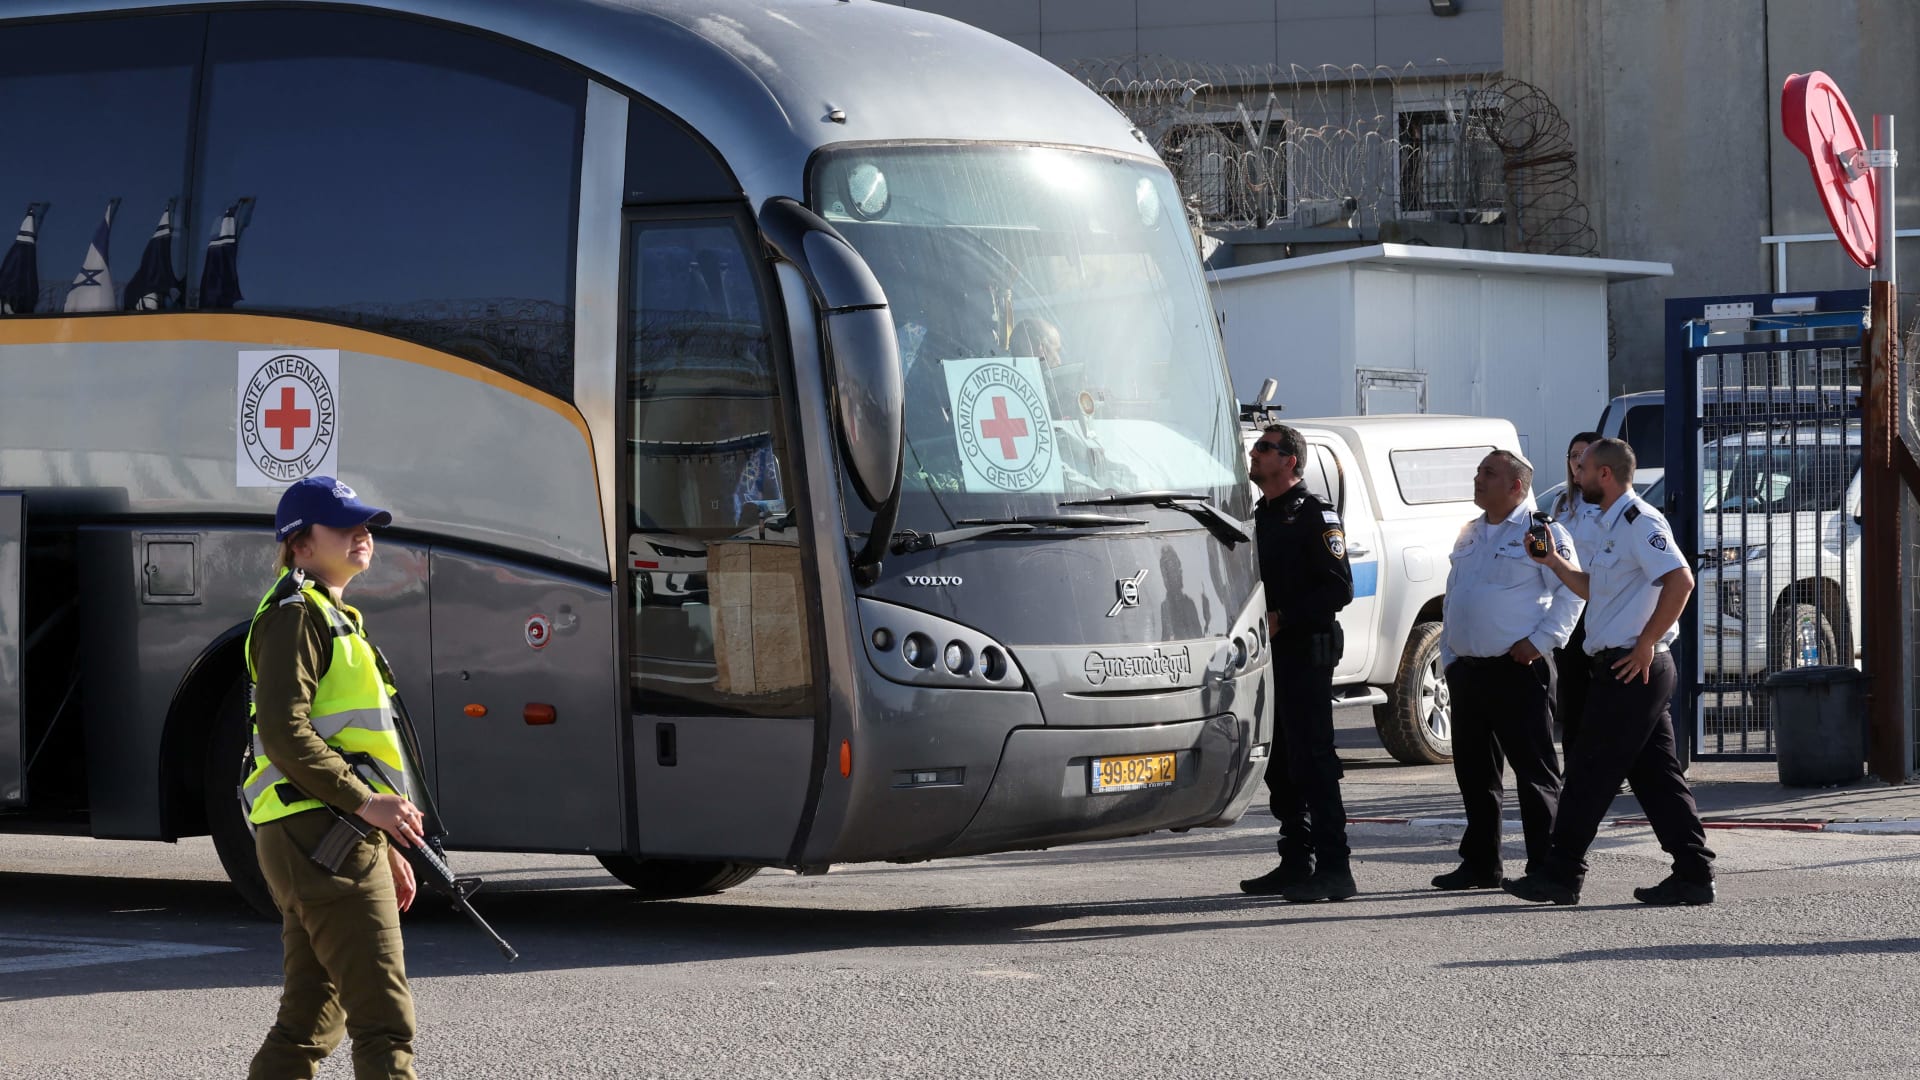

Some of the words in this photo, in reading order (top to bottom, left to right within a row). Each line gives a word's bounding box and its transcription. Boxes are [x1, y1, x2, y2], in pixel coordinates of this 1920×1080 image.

[244, 377, 265, 446] COMITE
[264, 359, 332, 446] INTERNATIONAL
[960, 387, 978, 458] COMITE
[972, 367, 1050, 454] INTERNATIONAL
[259, 454, 314, 478] GENEVE
[986, 463, 1042, 488] GENEVE
[905, 575, 963, 586] VOLVO
